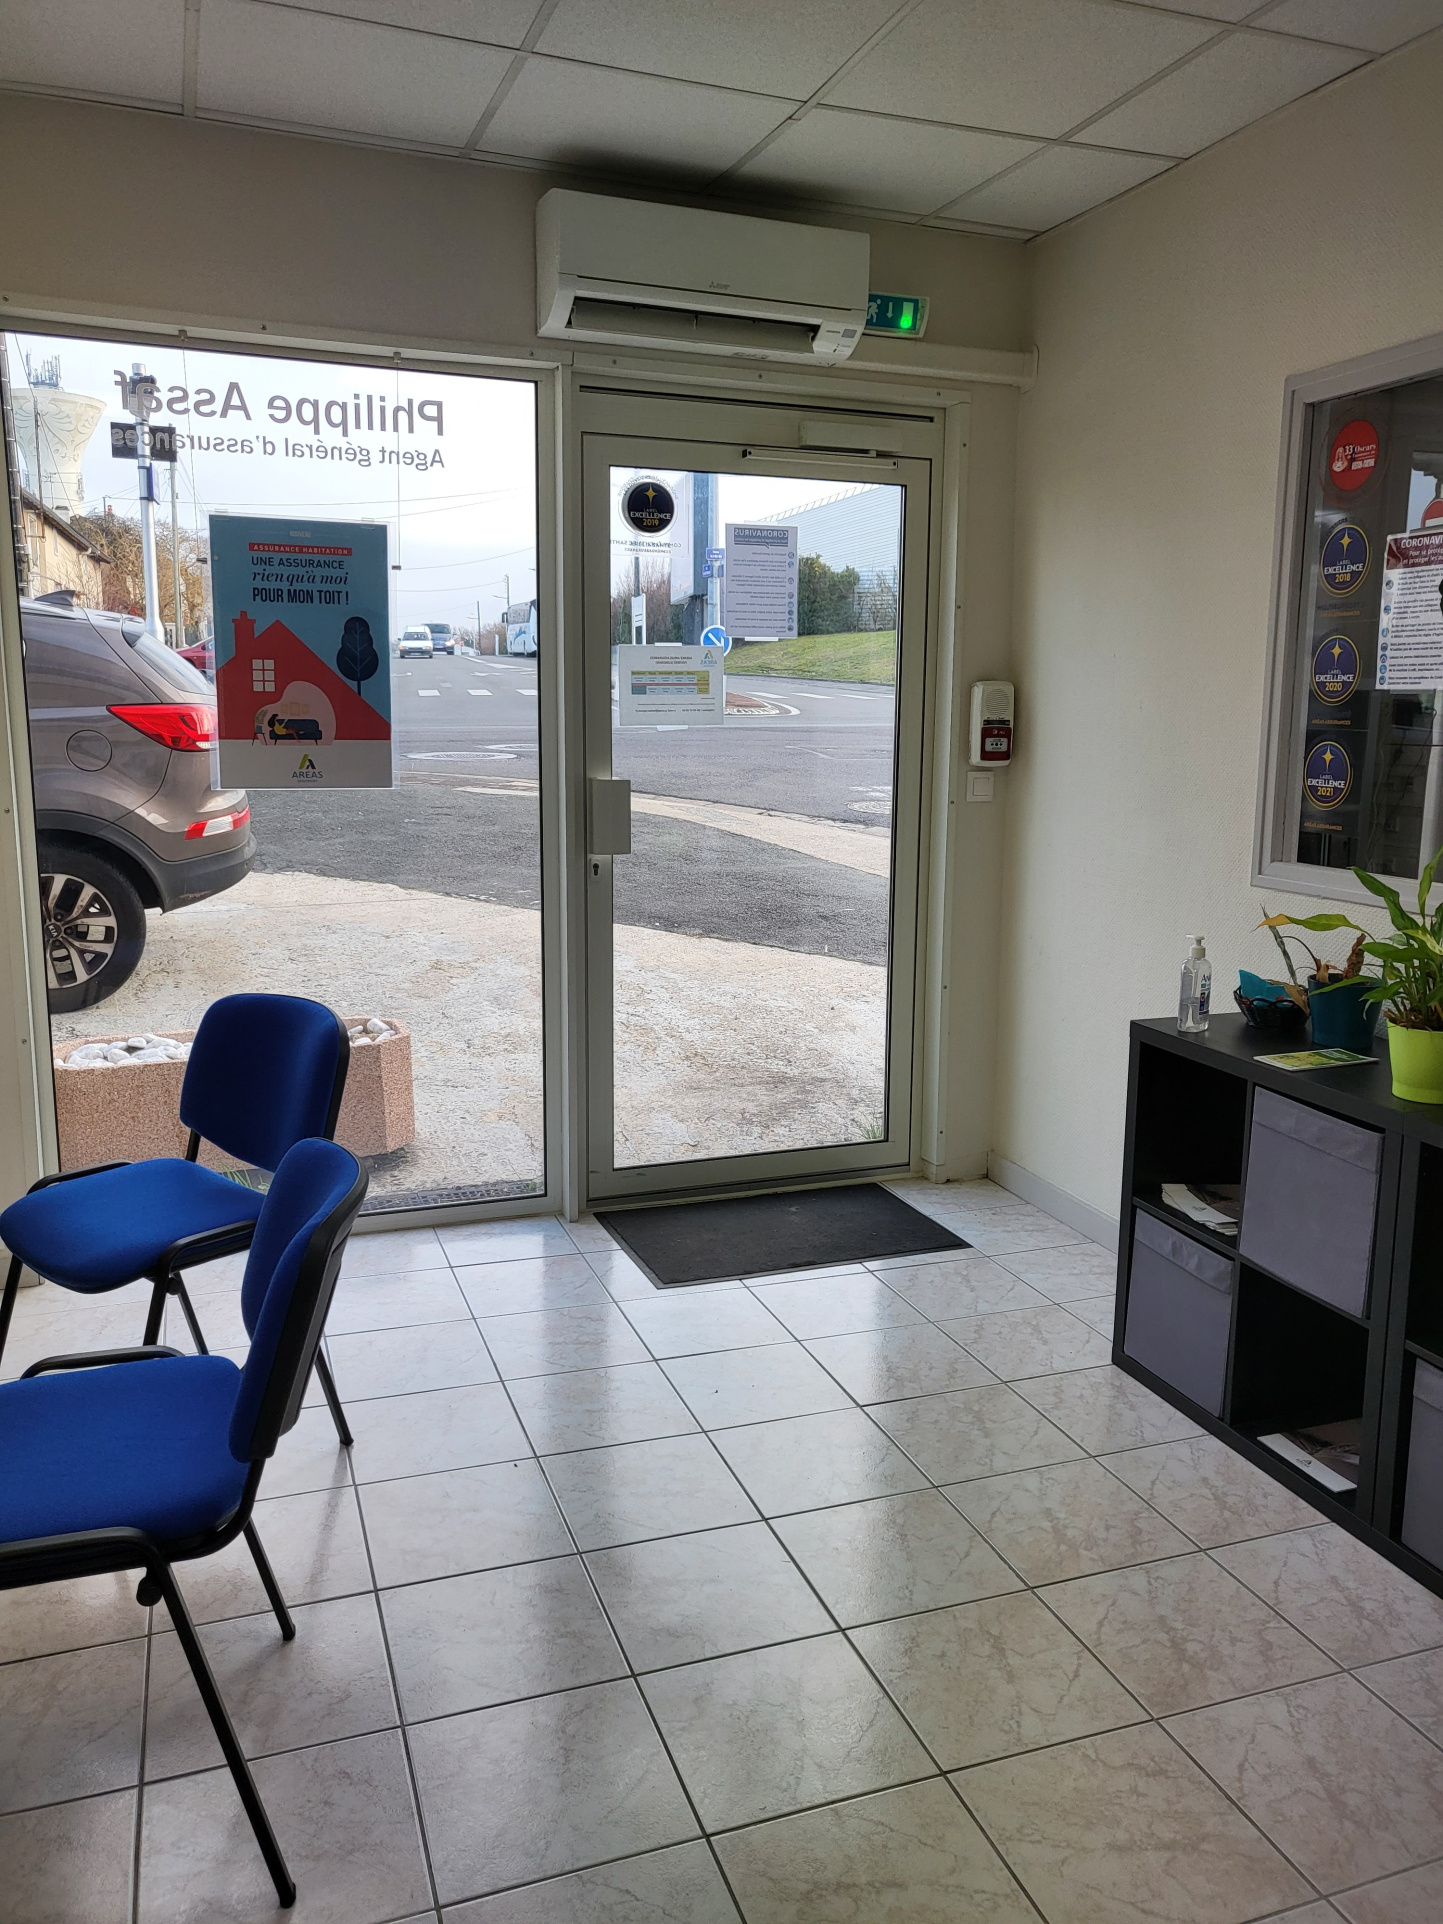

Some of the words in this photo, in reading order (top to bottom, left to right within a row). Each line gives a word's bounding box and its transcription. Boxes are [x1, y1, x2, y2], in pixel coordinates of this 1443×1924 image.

[630, 512, 672, 520] EXCELLENCE
[253, 544, 300, 552] ASSURANCE
[252, 556, 275, 567] UNE
[278, 557, 345, 570] ASSURANCE
[1324, 563, 1364, 574] EXCELLENCE
[252, 568, 284, 582] rien
[286, 570, 316, 586] qu'à
[320, 572, 349, 585] moi
[1335, 573, 1351, 583] 2018
[252, 587, 284, 603] POUR
[288, 588, 314, 604] MON
[317, 590, 342, 605] TOIT
[1315, 673, 1354, 682] EXCELLENCE
[1325, 682, 1342, 691] 2020
[1308, 779, 1345, 788] EXCELLENCE
[1317, 787, 1334, 796] 2021
[49, 925, 58, 937] KIA
